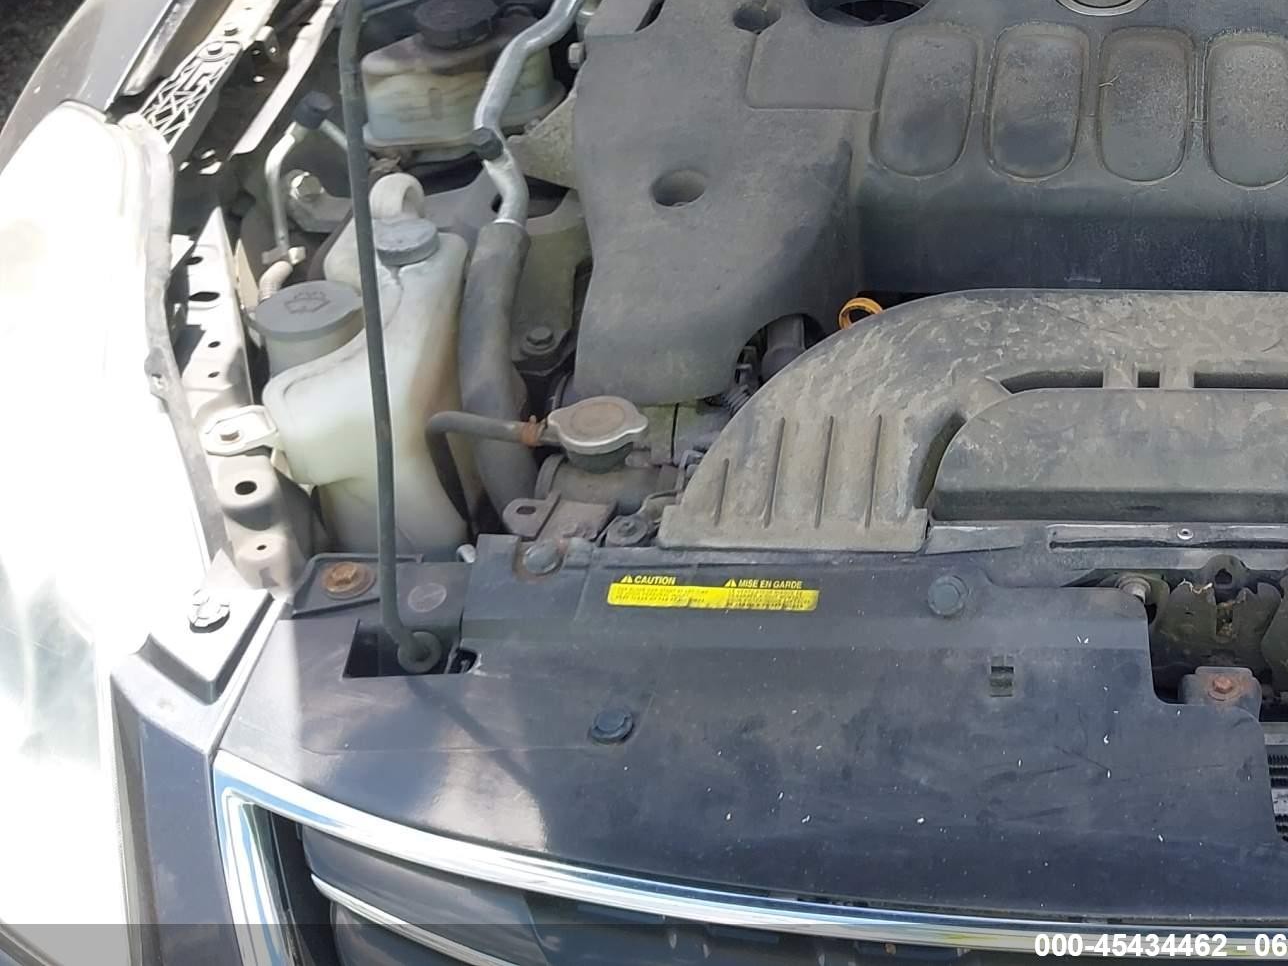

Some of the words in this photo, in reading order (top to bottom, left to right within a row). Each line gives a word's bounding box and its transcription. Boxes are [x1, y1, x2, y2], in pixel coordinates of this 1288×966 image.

[634, 575, 677, 585] CAUTION
[738, 579, 758, 588] MISE
[759, 580, 772, 588] EN
[772, 580, 803, 589] GARDE
